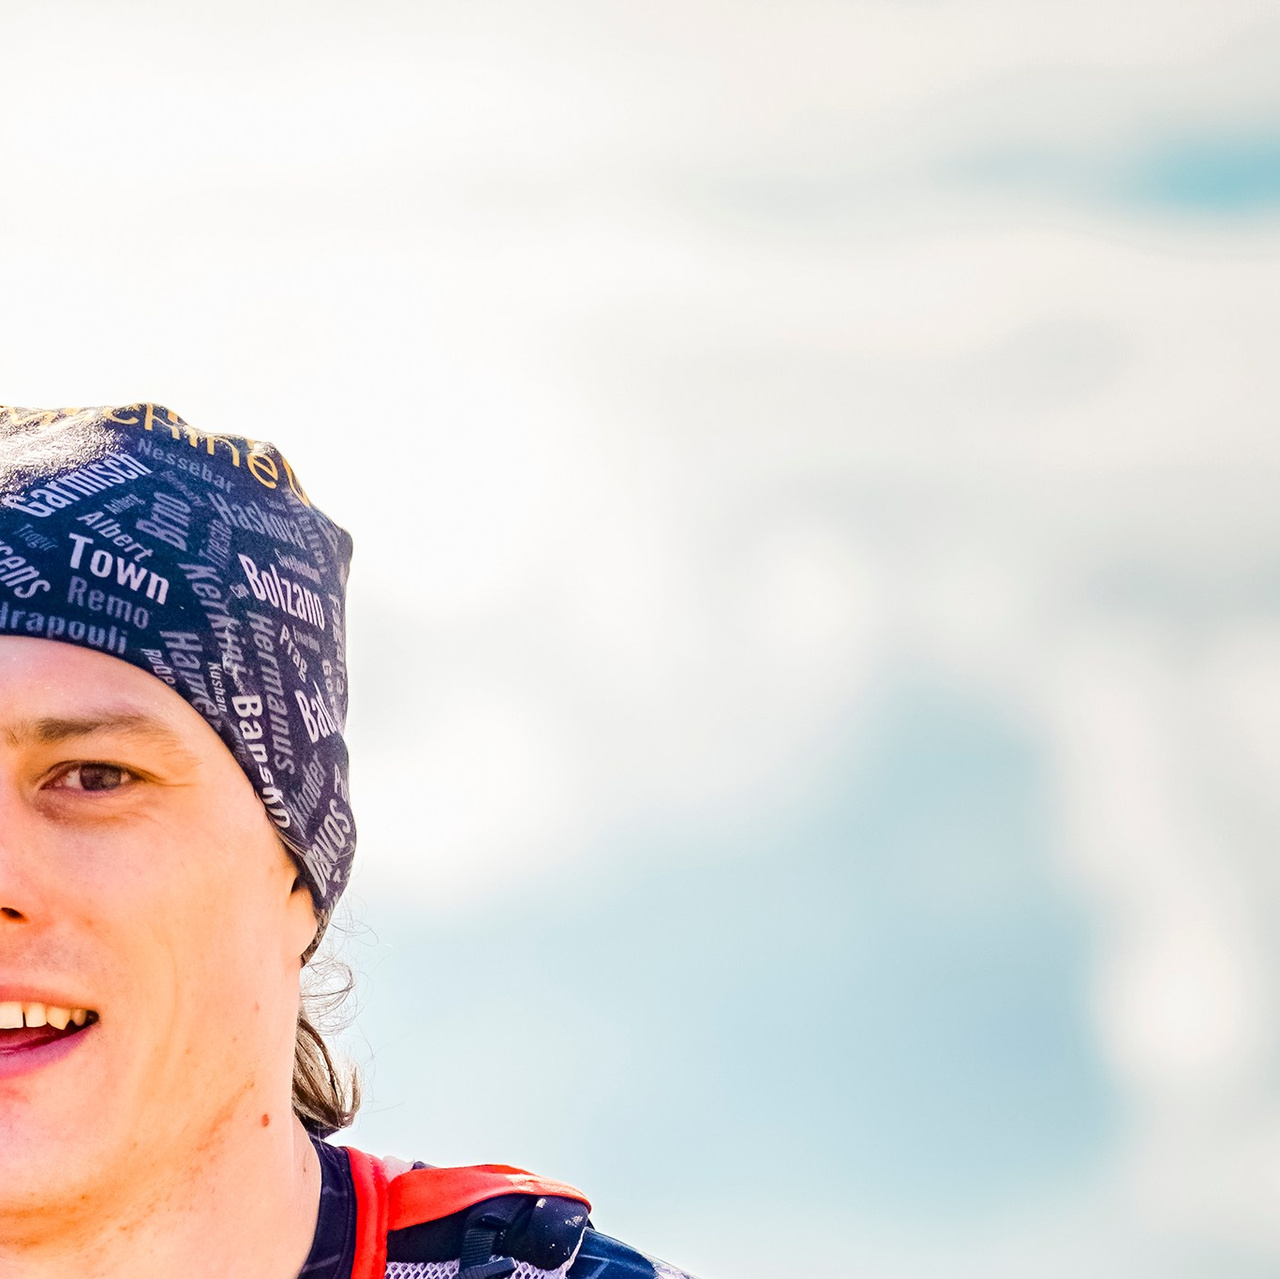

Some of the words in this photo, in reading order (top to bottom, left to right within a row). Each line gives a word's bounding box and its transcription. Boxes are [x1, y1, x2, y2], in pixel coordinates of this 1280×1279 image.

[4, 449, 152, 518] Garmisch
[69, 532, 170, 606] Town
[76, 511, 154, 563] Albert
[67, 575, 150, 630] Remo
[238, 554, 326, 631] Bolzano
[246, 610, 296, 775] Hermanus
[232, 694, 291, 829] Bansko
